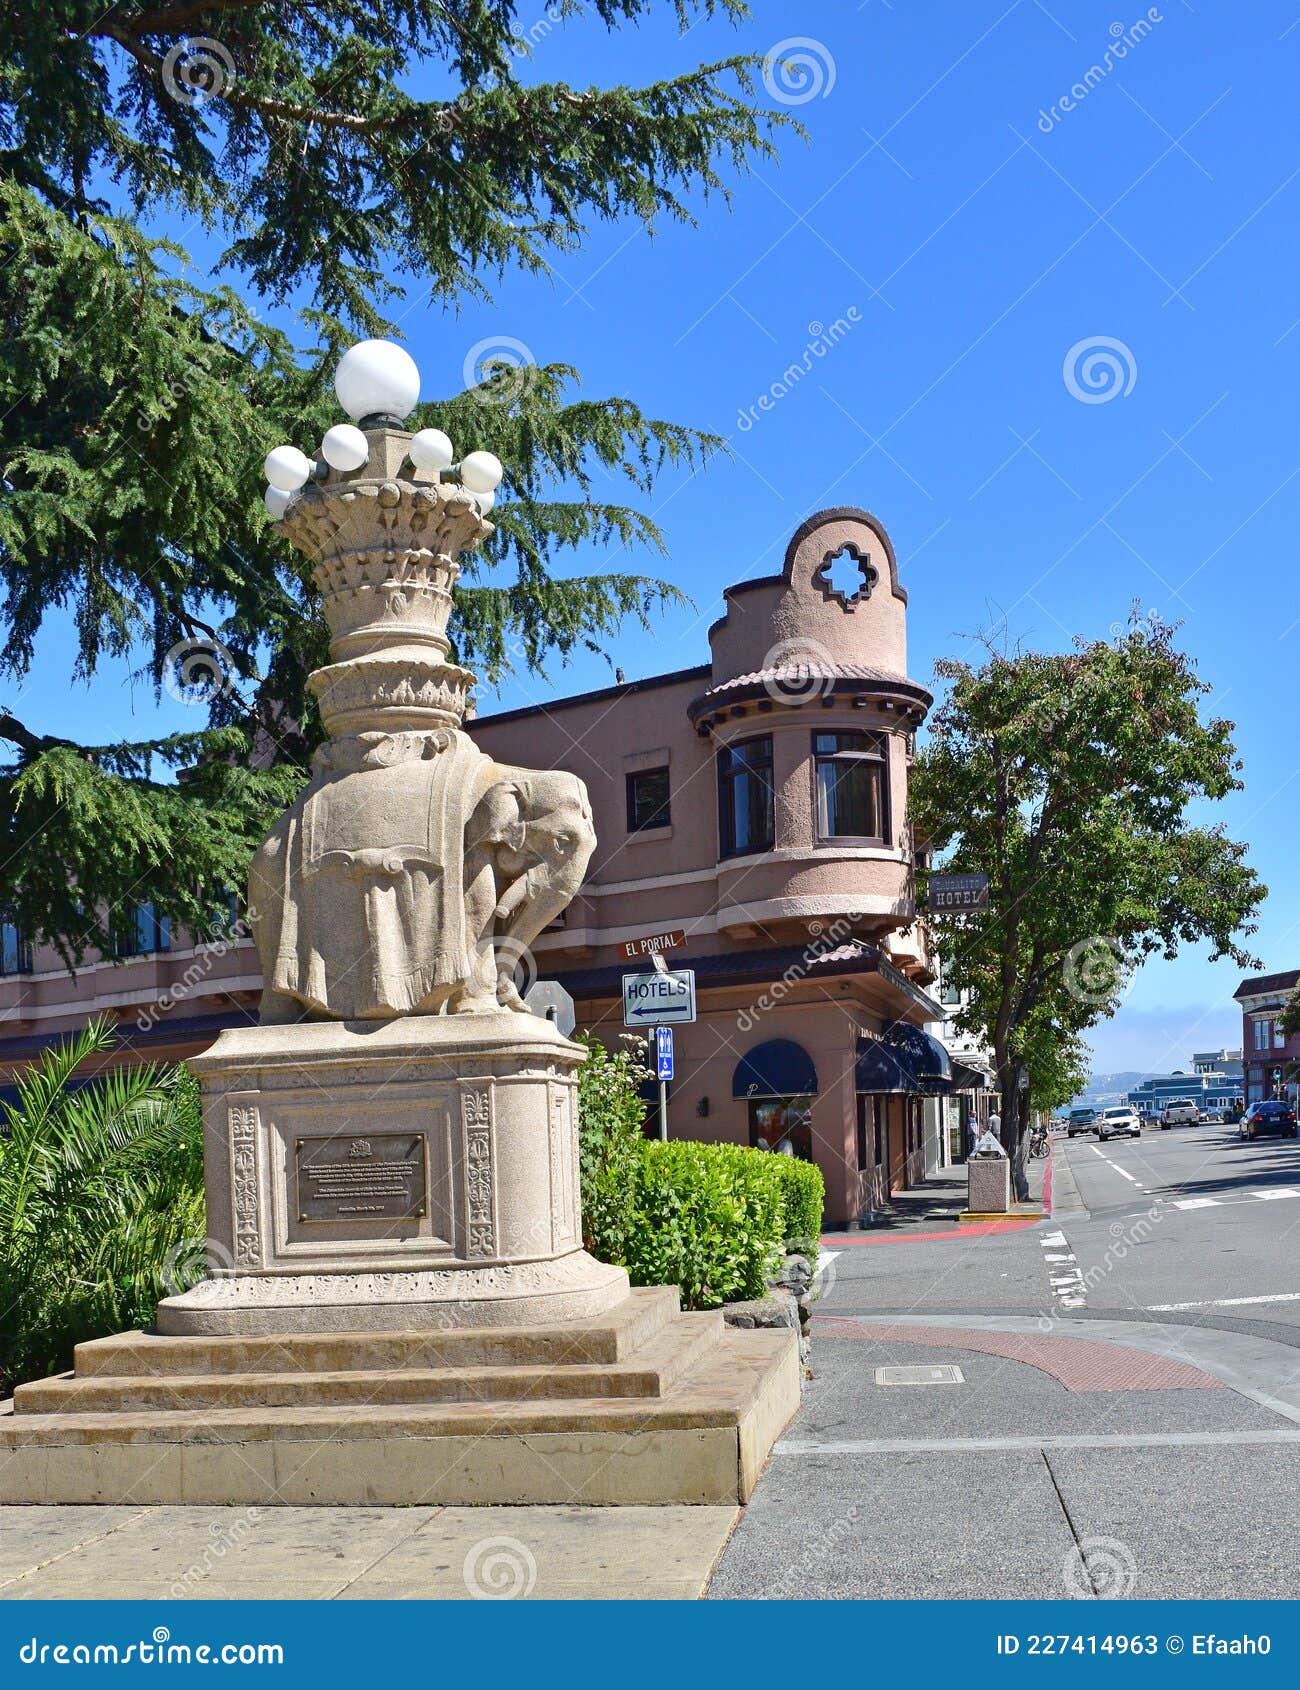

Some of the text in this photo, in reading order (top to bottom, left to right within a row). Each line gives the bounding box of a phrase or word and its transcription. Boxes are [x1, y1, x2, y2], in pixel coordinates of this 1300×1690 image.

[936, 891, 980, 905] HOTEL
[625, 934, 678, 957] EL PORTAL
[628, 981, 687, 999] HOTELS
